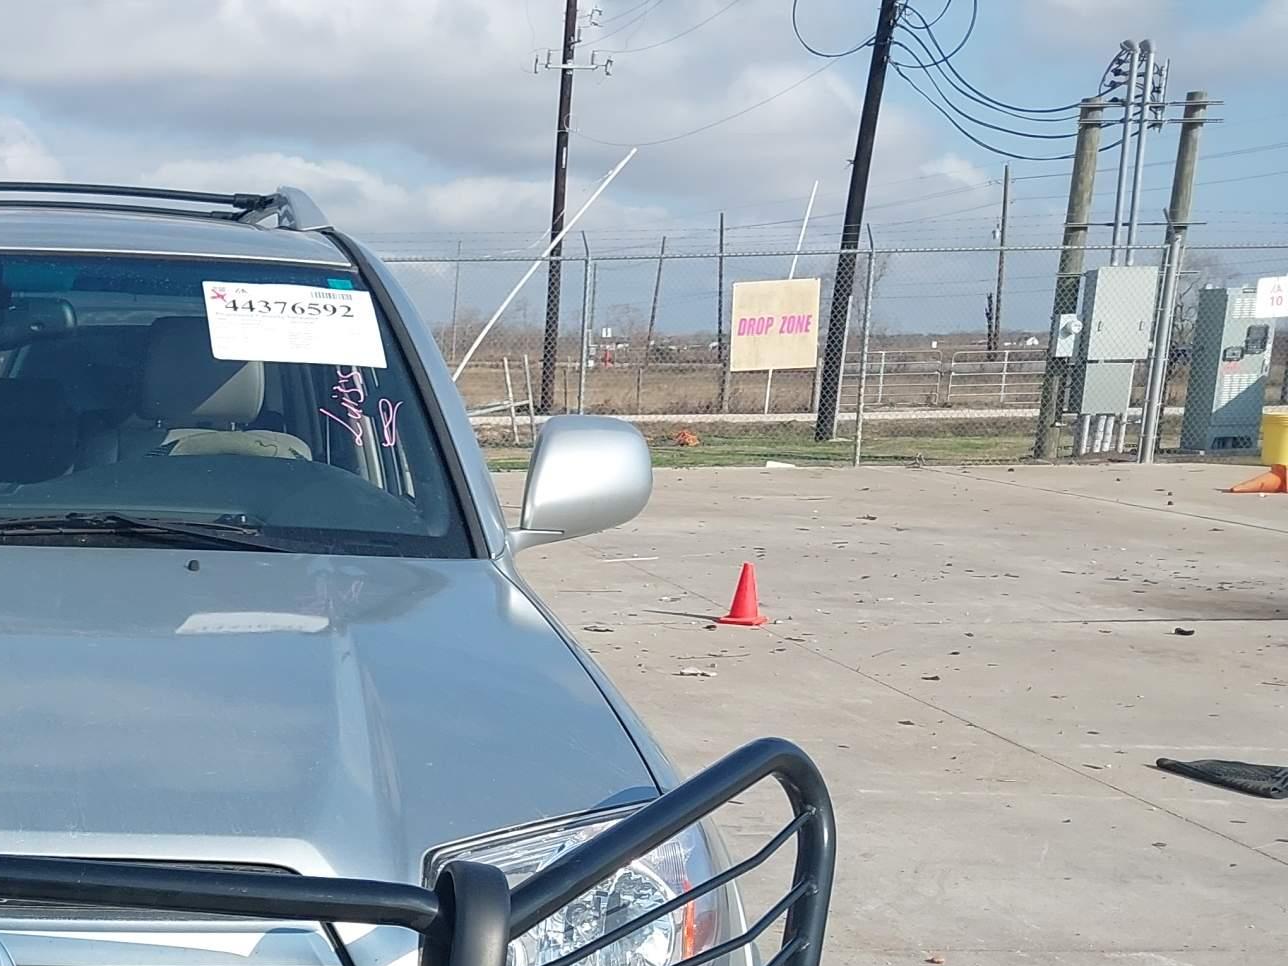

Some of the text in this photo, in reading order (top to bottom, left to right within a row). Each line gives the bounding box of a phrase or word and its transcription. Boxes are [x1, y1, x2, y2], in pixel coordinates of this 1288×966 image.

[225, 299, 354, 318] 44376592
[737, 314, 813, 336] DROP ZONE
